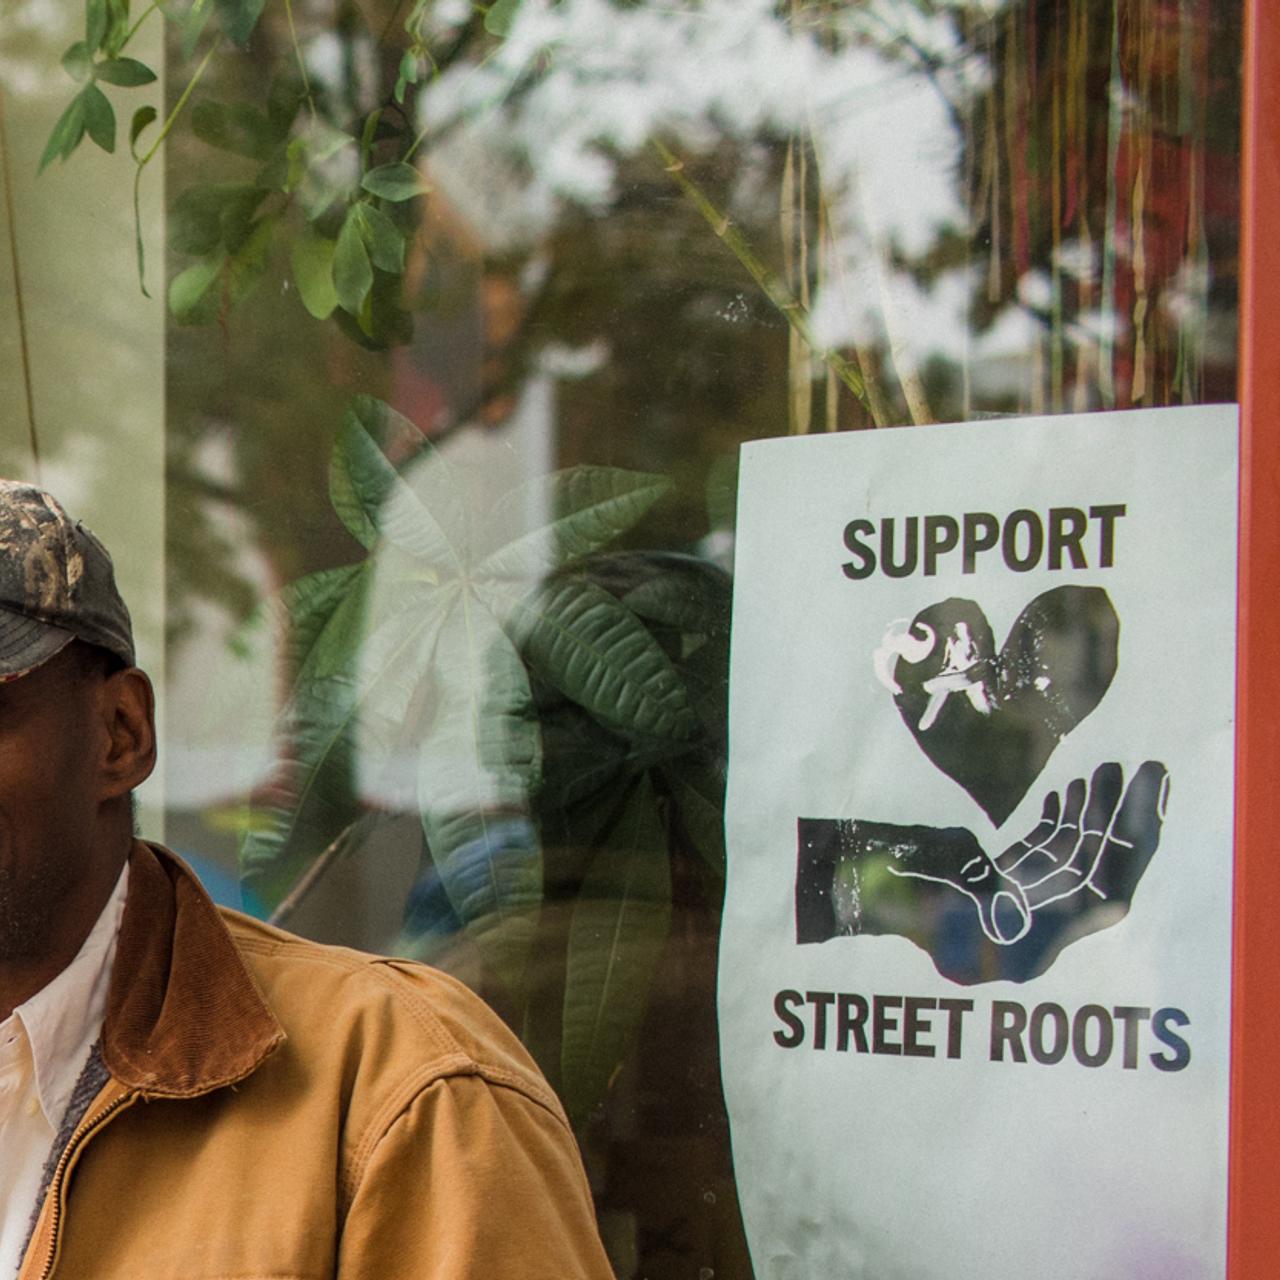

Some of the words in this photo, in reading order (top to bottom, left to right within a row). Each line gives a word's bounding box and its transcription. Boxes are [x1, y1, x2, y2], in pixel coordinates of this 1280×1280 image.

[841, 504, 1126, 579] SUPPORT
[773, 990, 974, 1058] STREET
[989, 1000, 1191, 1072] ROOTS
